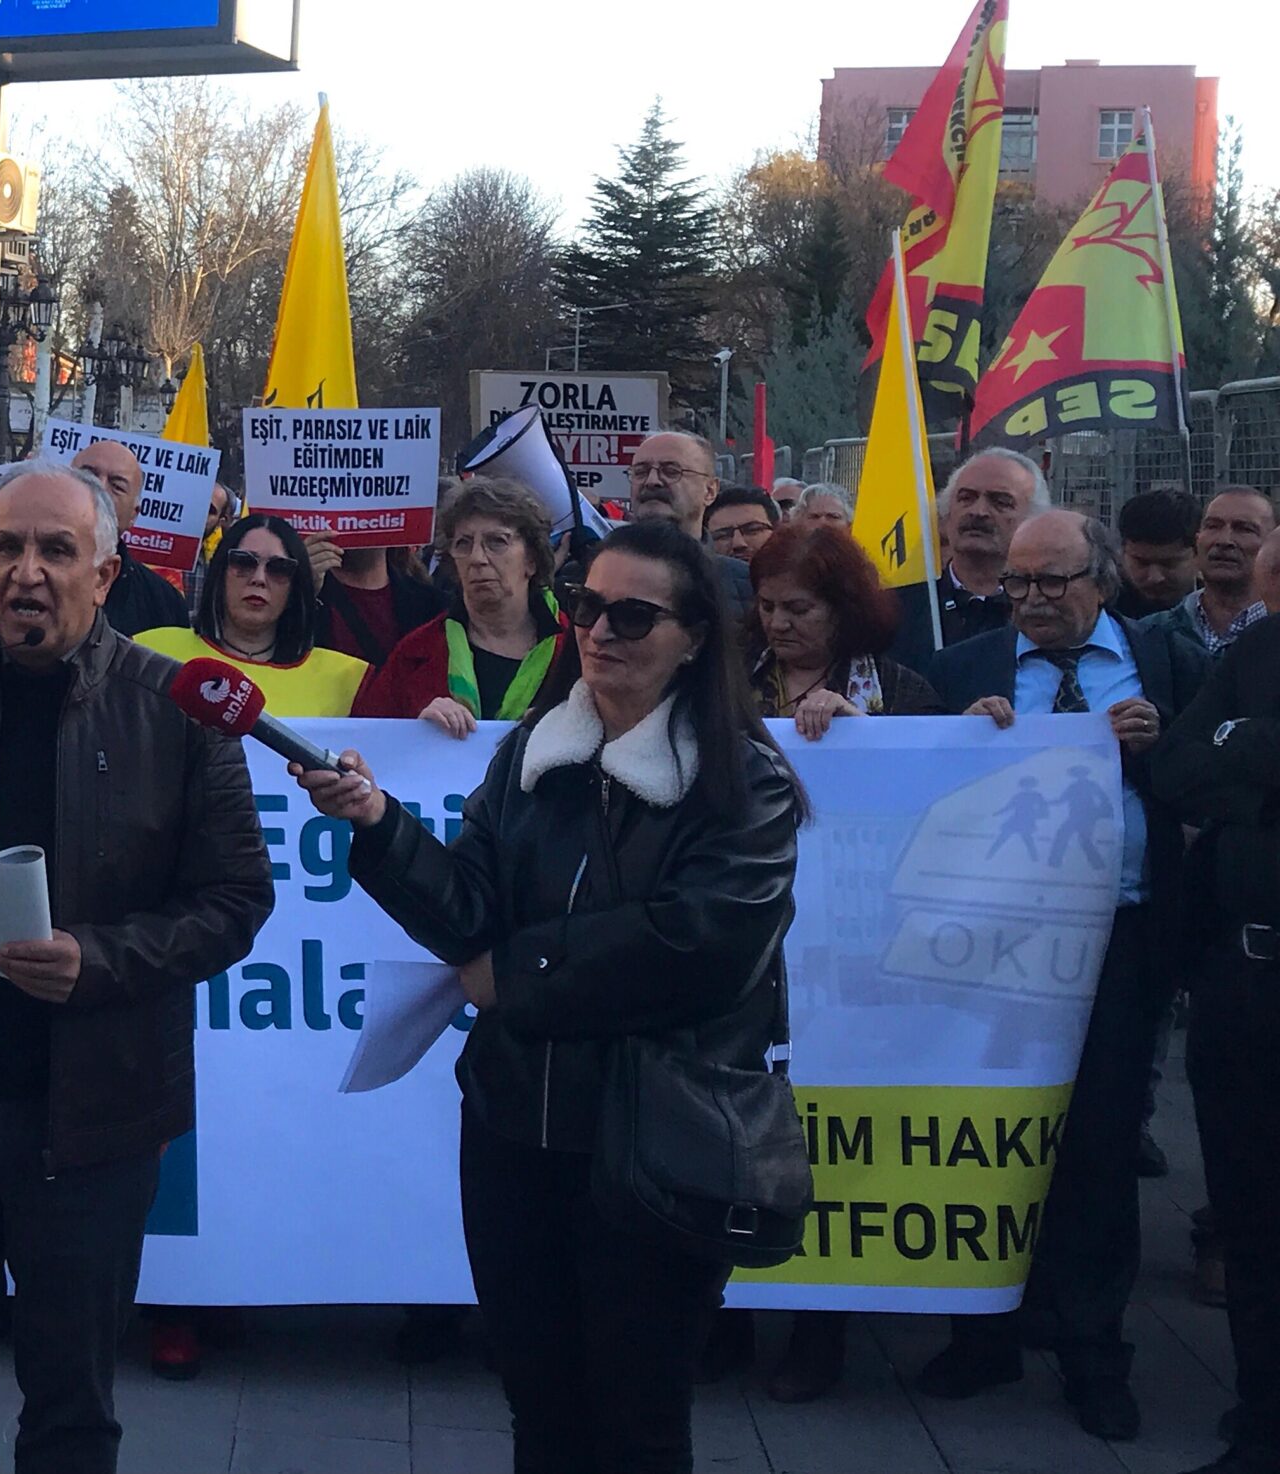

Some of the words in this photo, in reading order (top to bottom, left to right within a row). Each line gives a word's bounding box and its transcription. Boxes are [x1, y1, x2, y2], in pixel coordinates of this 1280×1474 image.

[520, 382, 617, 411] ZORLA
[251, 414, 287, 446] EŞİT,
[293, 418, 362, 440] PARASIZ
[368, 418, 388, 440] VE
[394, 414, 431, 440] LAİK
[155, 448, 173, 468] VE
[177, 452, 211, 476] LAİK
[293, 443, 384, 469] EĞİTİMDEN
[269, 472, 410, 505] VAZGEÇMİYORUZ!
[284, 513, 332, 531] aiklik
